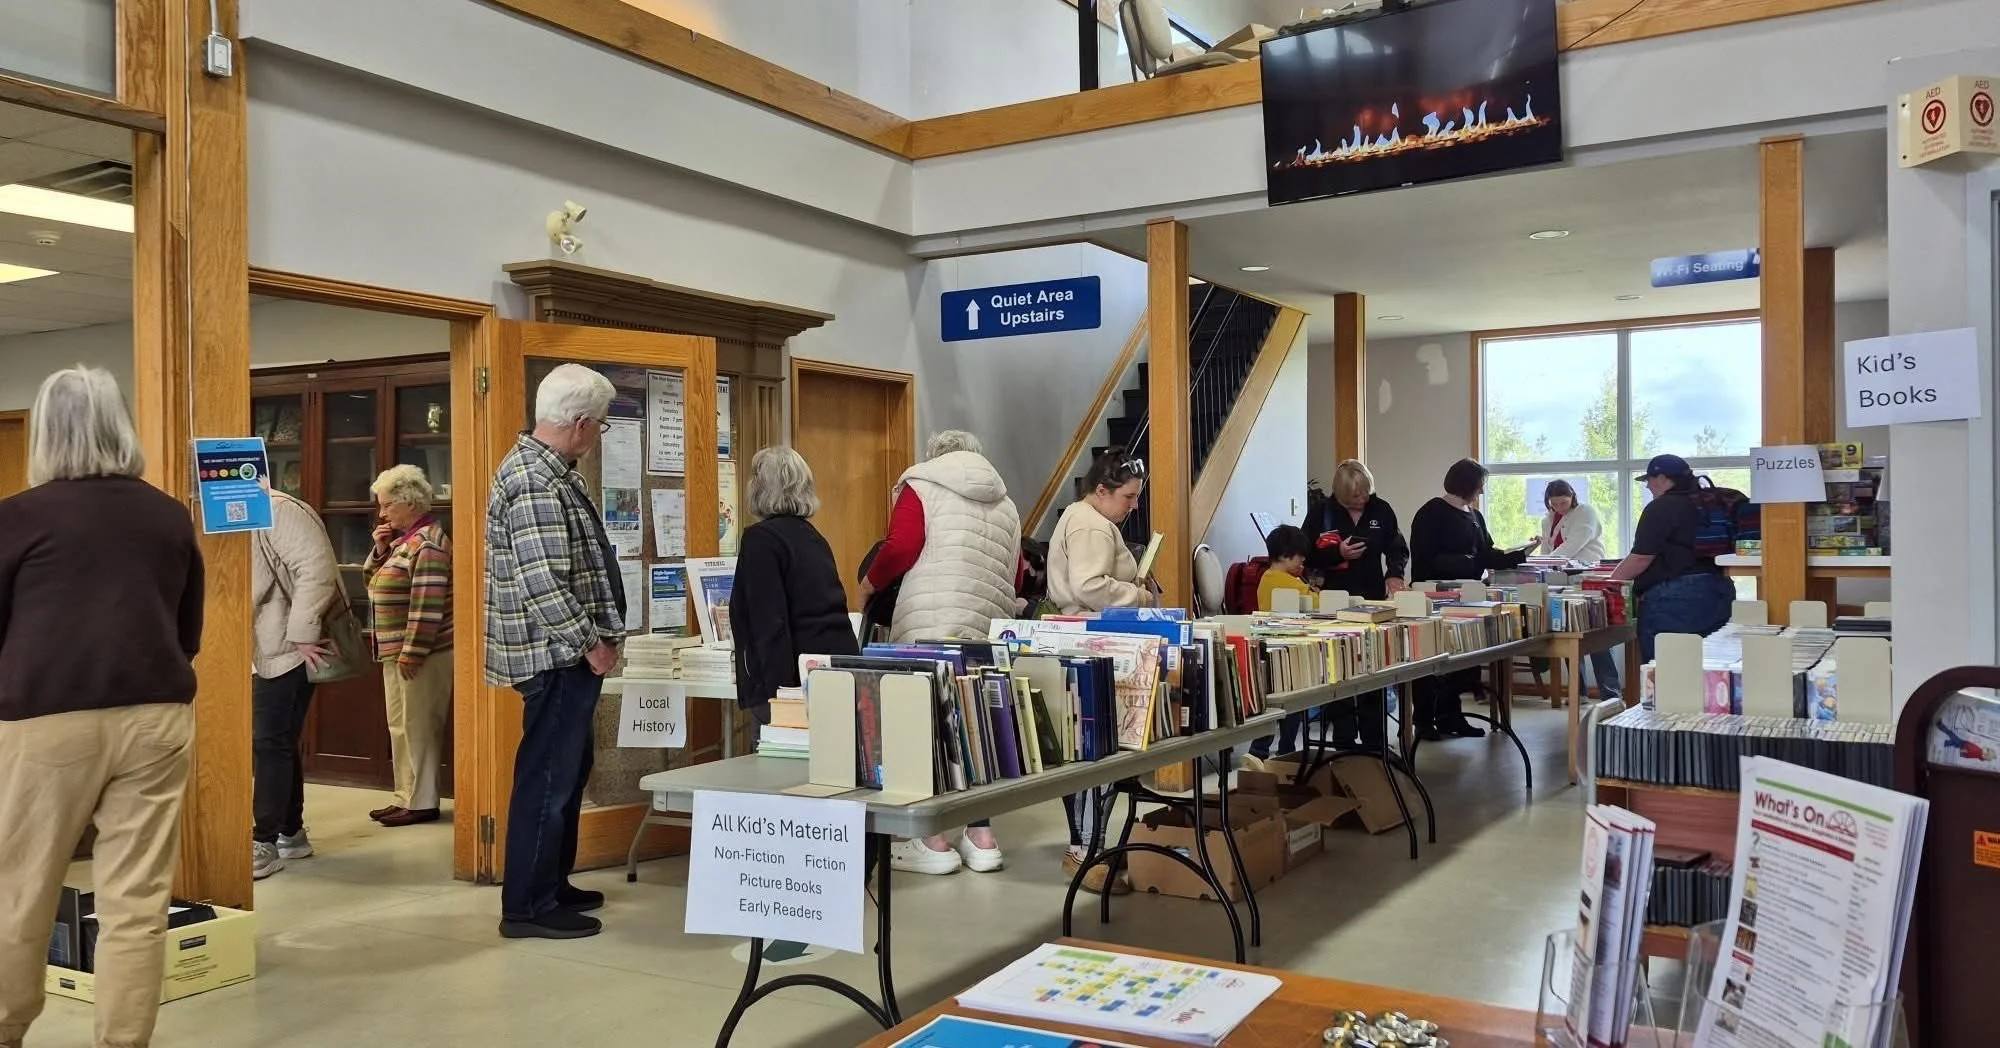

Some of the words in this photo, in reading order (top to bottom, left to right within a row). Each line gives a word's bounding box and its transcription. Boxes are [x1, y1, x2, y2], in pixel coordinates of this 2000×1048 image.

[1926, 87, 1941, 99] AED
[1975, 80, 1990, 89] AED
[1693, 259, 1745, 274] Seating
[991, 292, 1032, 308] Quiet
[1037, 290, 1074, 304] Area
[1000, 308, 1065, 328] Upstairs
[1857, 352, 1917, 375] Kid's
[1858, 385, 1938, 408] Books
[1846, 444, 1857, 456] 9
[1755, 456, 1815, 471] Puzzles
[704, 560, 726, 568] TITANIC
[639, 696, 670, 709] Local
[632, 719, 676, 735] History
[1754, 791, 1800, 819] What's
[1803, 805, 1826, 827] On
[711, 814, 733, 832] All
[737, 815, 776, 836] Kid's
[780, 819, 849, 843] Material
[714, 846, 785, 865] Non-Fiction
[805, 854, 846, 872] Fiction
[739, 873, 782, 890] Picture
[785, 877, 823, 895] Books
[739, 898, 770, 917] Early
[773, 902, 823, 921] Readers
